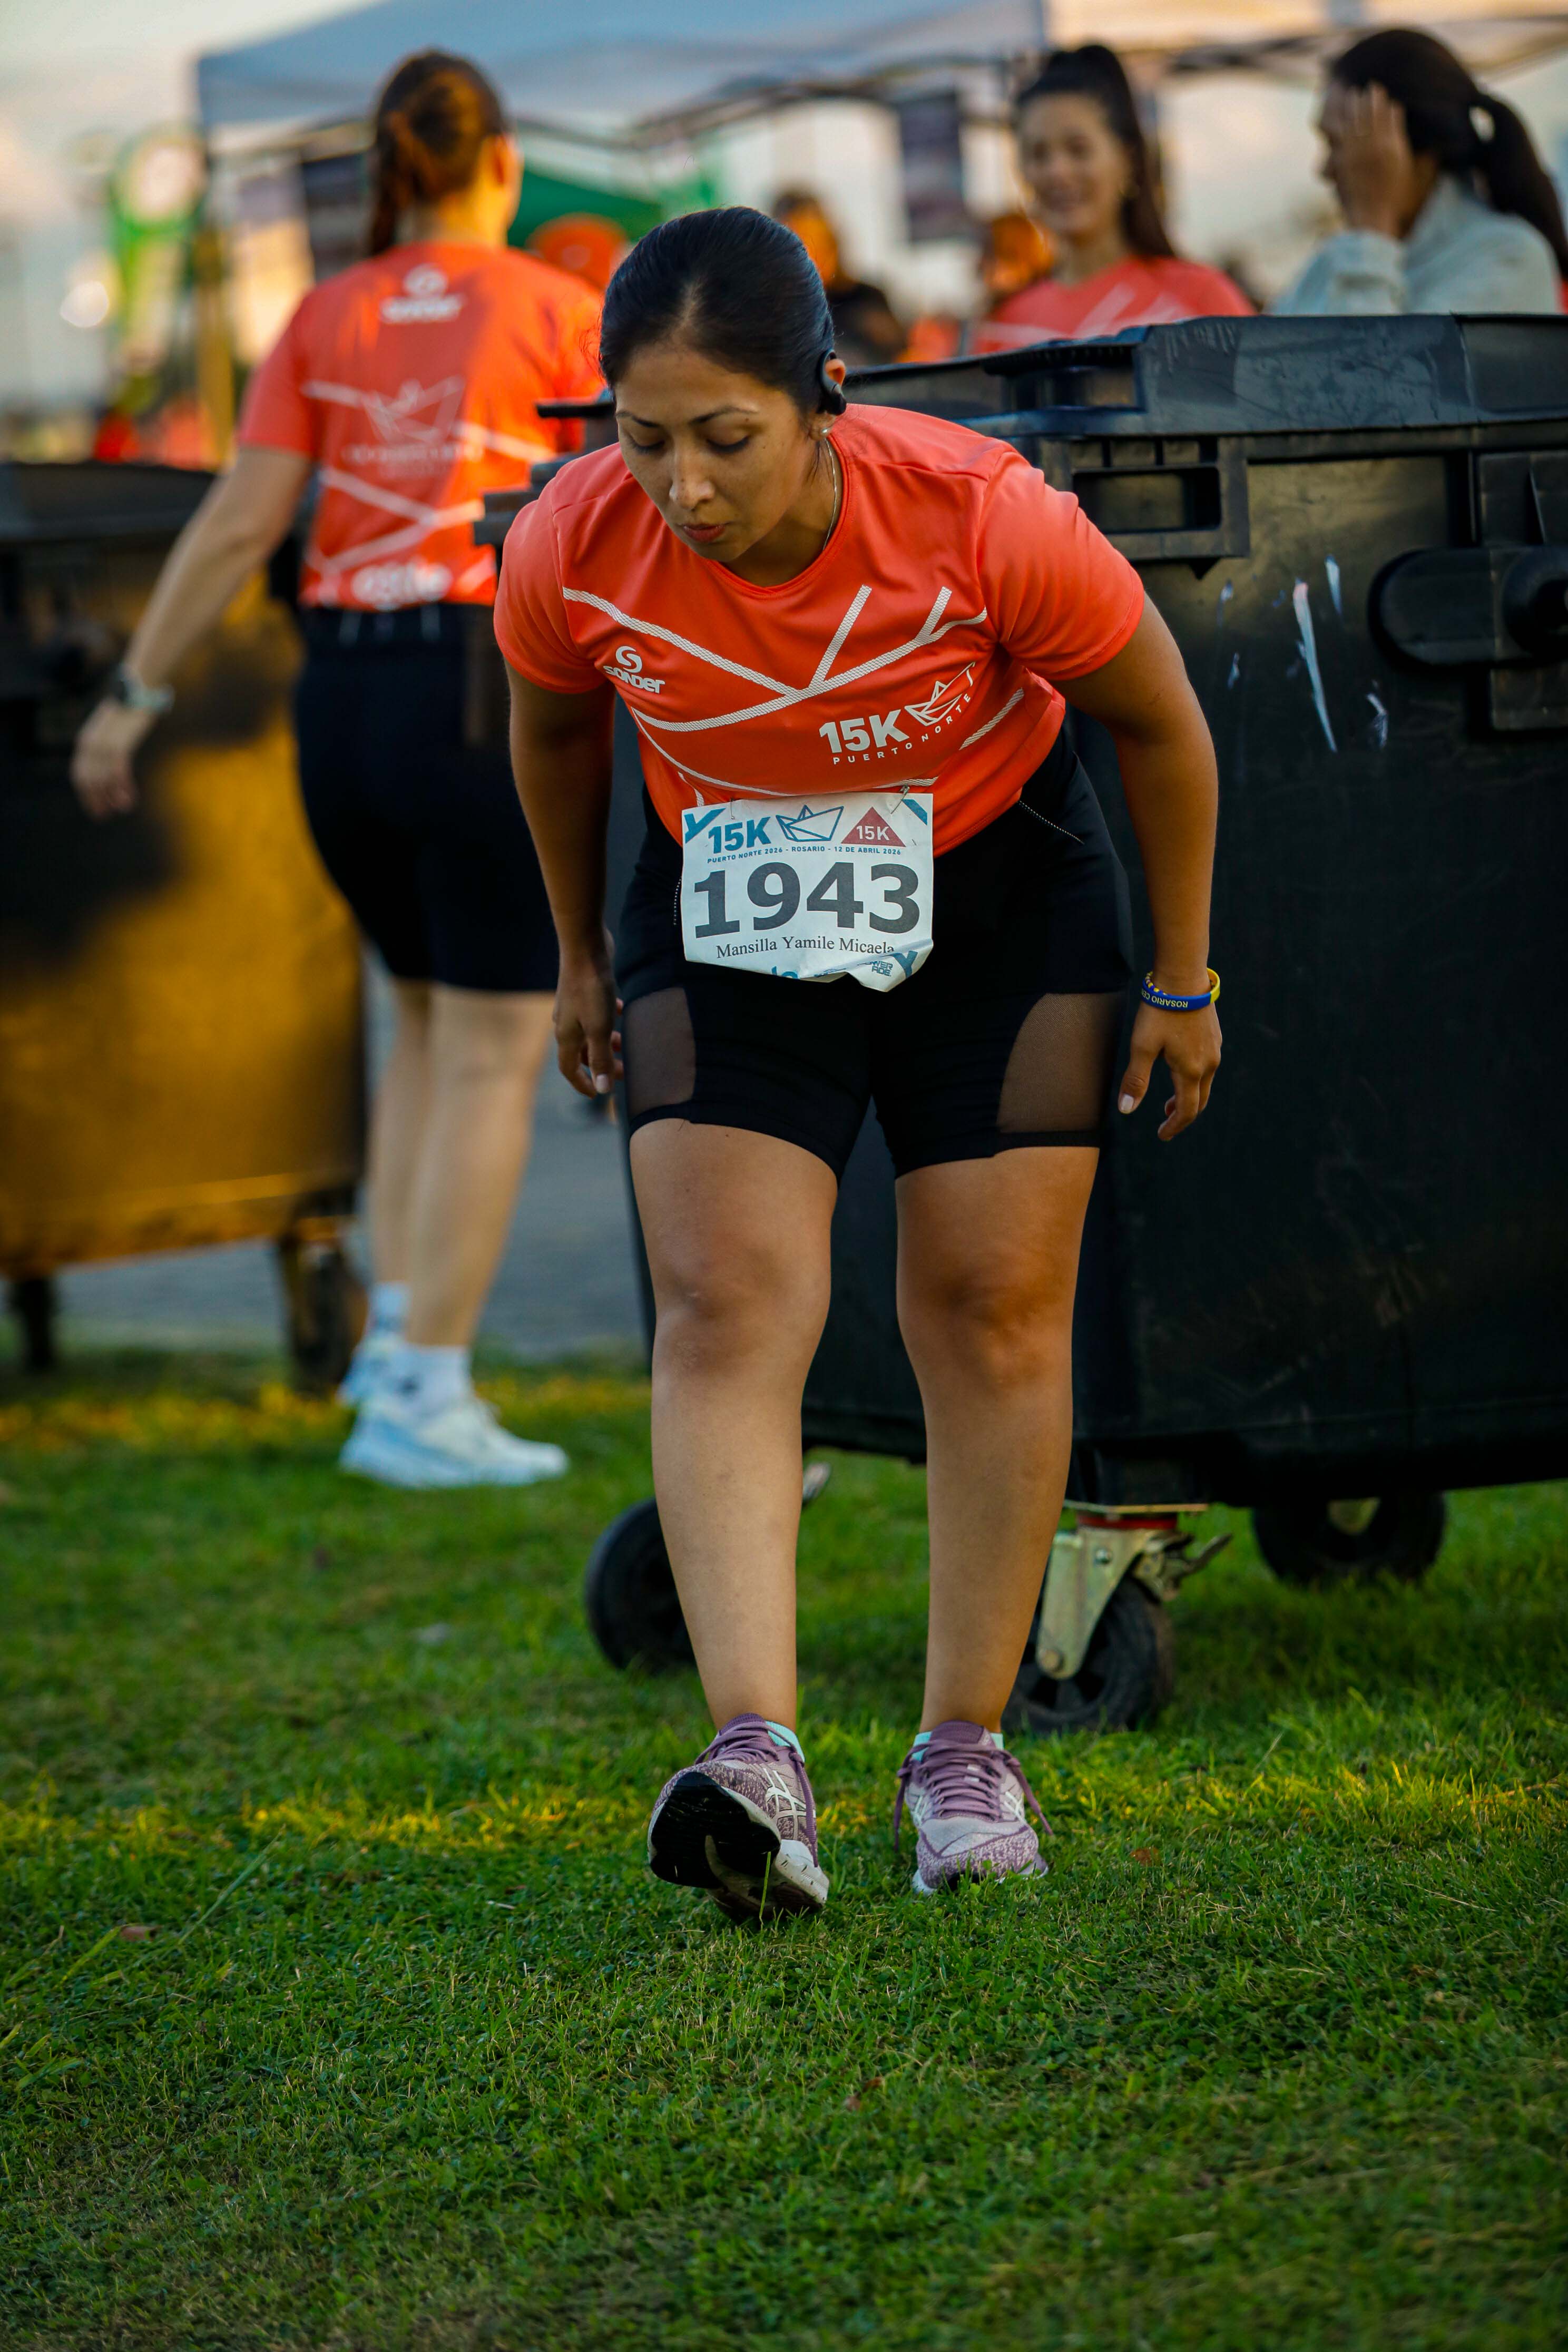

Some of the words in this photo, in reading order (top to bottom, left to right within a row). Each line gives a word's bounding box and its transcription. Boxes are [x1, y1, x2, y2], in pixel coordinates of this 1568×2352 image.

[819, 709, 909, 753] 15K
[833, 742, 913, 765] PUERTO
[922, 693, 971, 742] NORTE
[708, 816, 771, 854] 15K
[856, 825, 890, 840] 15K
[707, 854, 736, 864] PUERTO
[739, 849, 762, 859] NORTE
[694, 861, 920, 938] 1943
[716, 938, 777, 958] Mansilla
[782, 935, 835, 949] Yamile
[839, 937, 894, 954] Micaela
[1151, 995, 1188, 1008] ROSARIO
